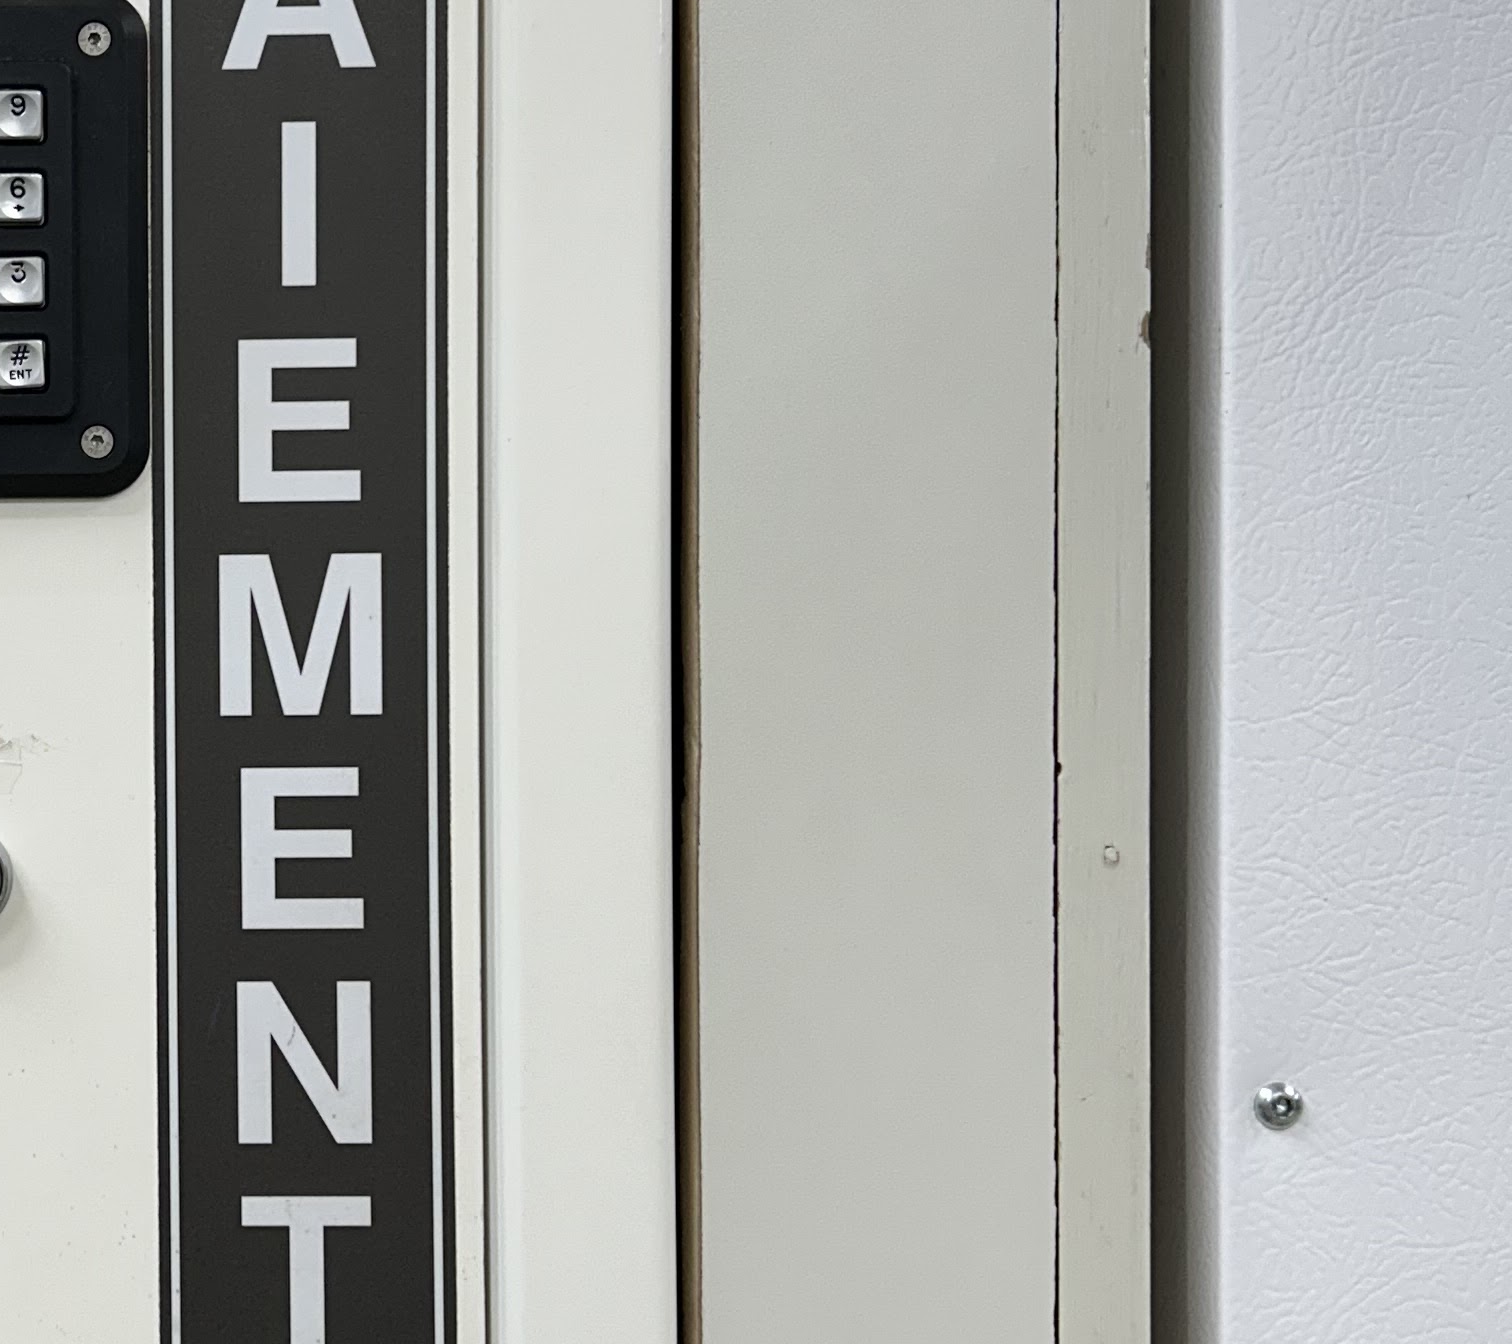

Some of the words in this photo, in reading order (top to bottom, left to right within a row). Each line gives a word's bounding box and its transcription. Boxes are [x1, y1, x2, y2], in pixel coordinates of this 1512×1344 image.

[11, 95, 26, 117] 9
[10, 177, 26, 199] 6
[11, 262, 26, 284] 3
[9, 368, 33, 381] ENT
